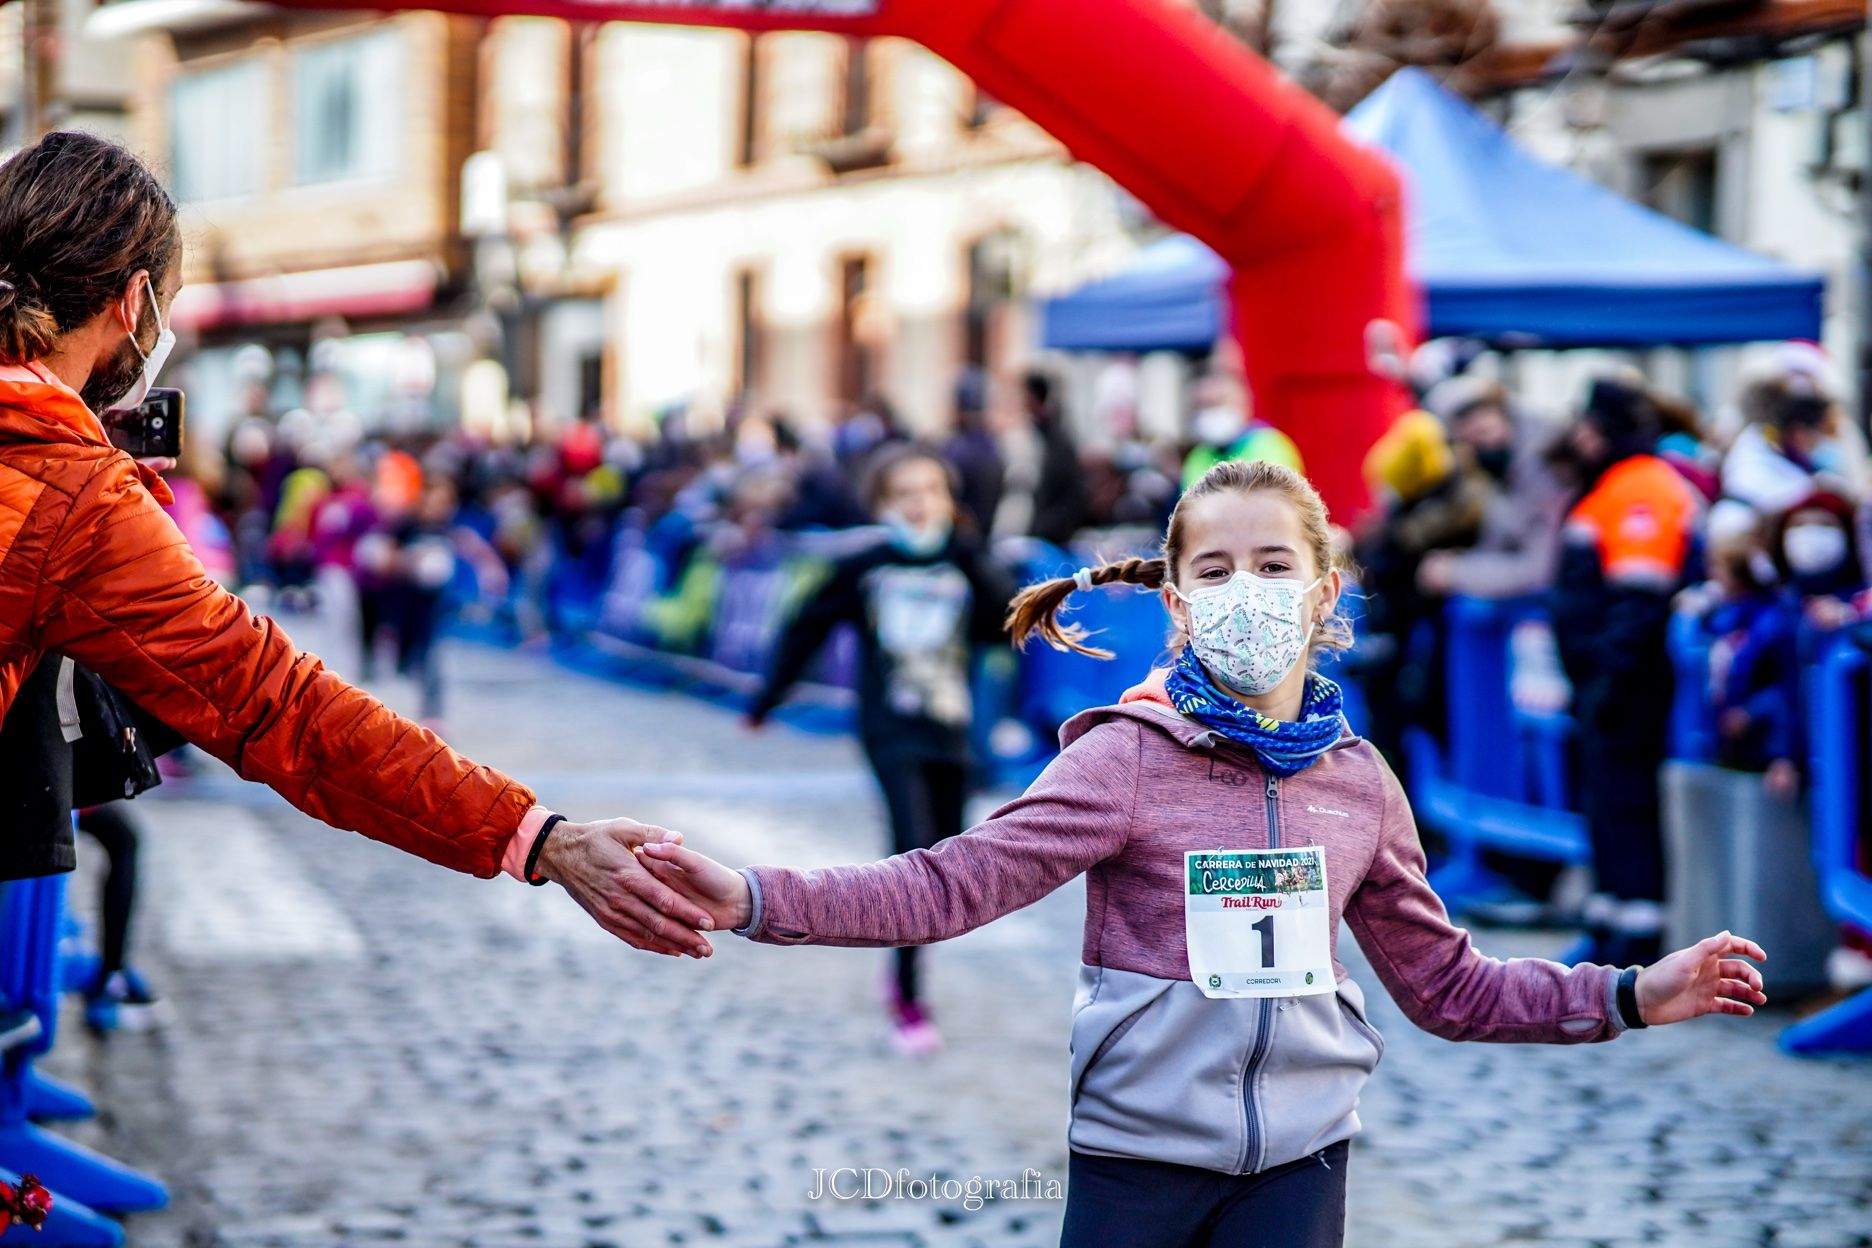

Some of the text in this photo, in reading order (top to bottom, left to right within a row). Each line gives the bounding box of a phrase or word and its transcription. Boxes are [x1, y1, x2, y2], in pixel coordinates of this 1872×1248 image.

[1194, 860, 1243, 869] CARRERA
[1258, 858, 1299, 869] NAVIDAD
[1221, 896, 1282, 909] Trail Run
[1252, 915, 1275, 968] 1
